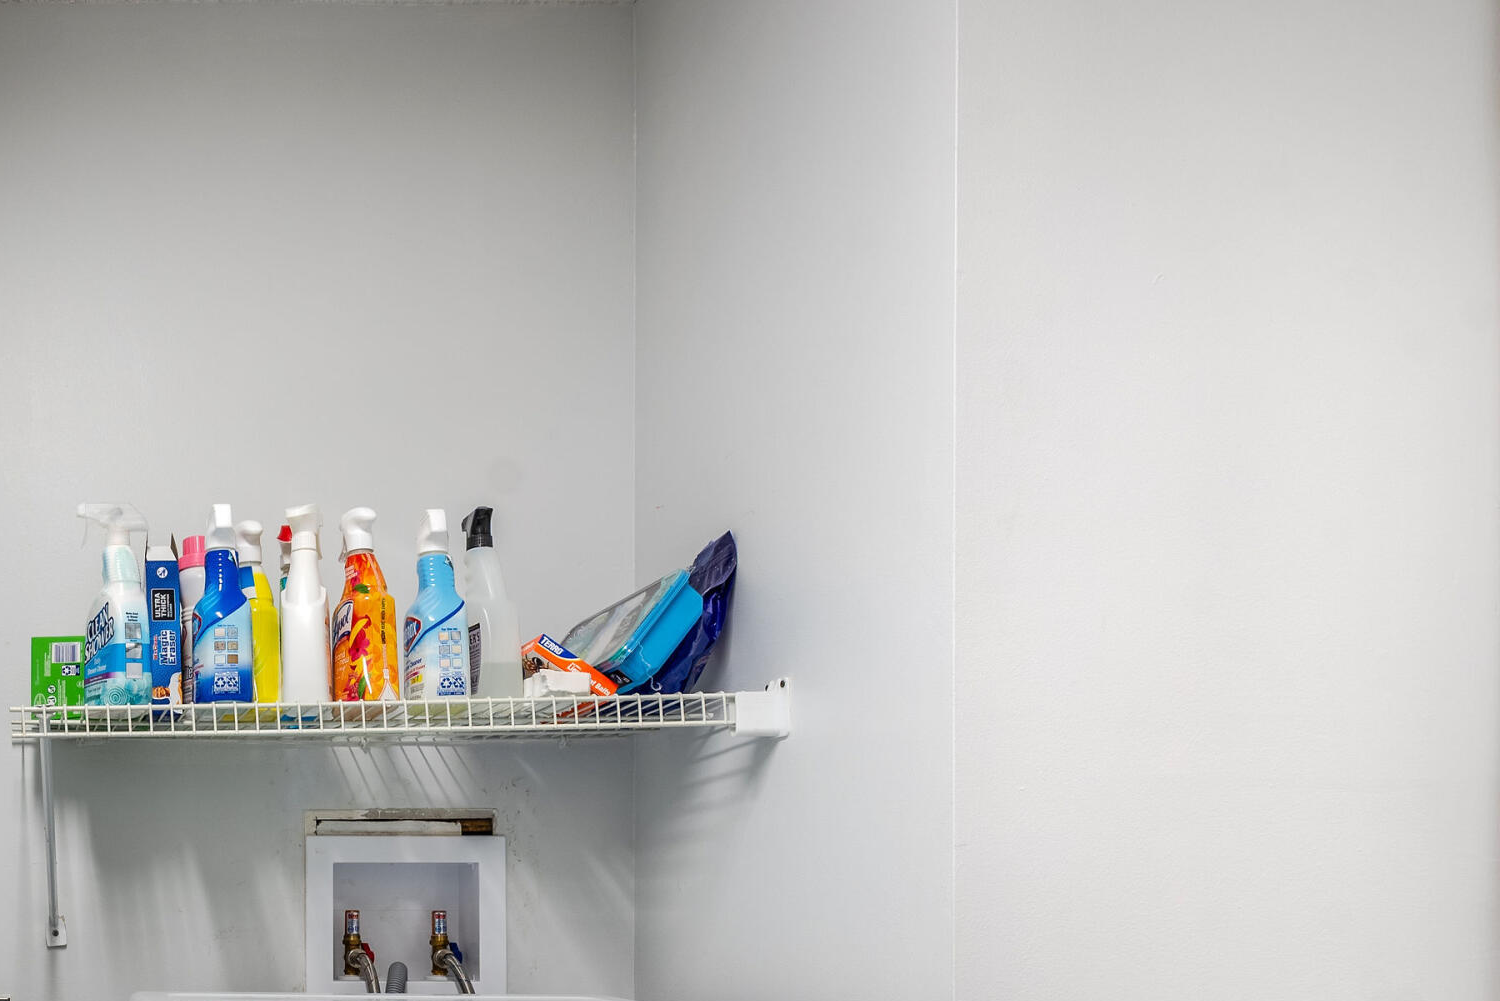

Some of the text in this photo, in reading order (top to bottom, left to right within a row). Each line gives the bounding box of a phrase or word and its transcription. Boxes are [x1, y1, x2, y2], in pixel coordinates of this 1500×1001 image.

[87, 602, 108, 641] CLEAN
[85, 617, 114, 664] SHOWER
[160, 630, 169, 664] Magic
[541, 637, 564, 655] TERRO
